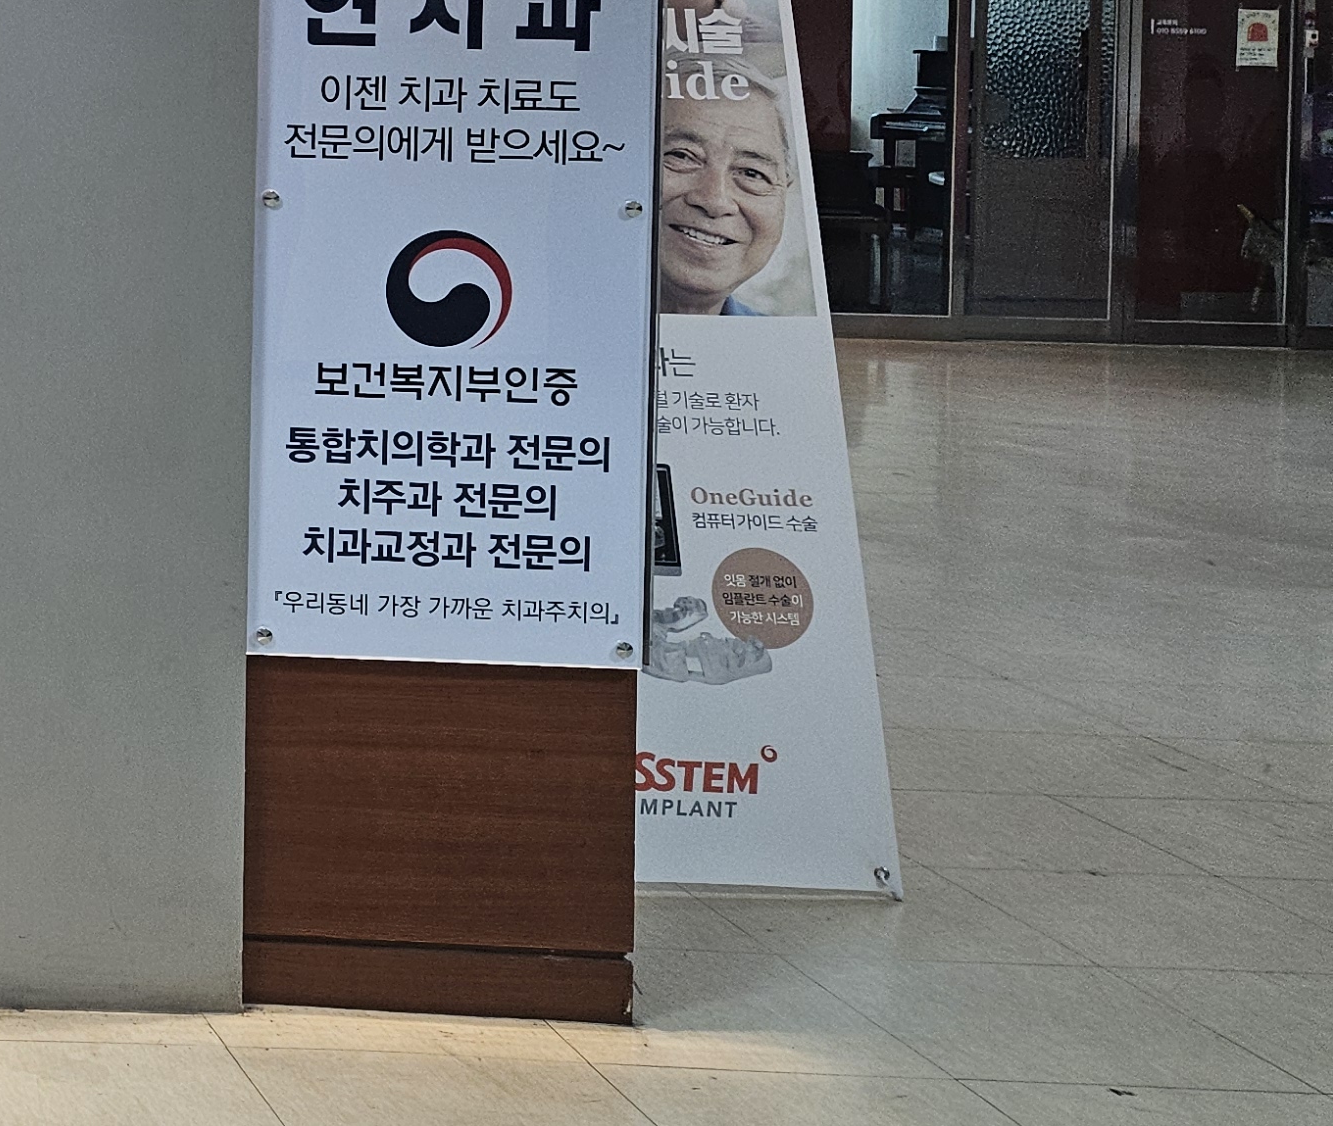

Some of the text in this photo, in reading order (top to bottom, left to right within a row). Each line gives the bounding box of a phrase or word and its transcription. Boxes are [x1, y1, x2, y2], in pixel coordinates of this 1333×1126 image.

[320, 75, 581, 114] 이젠 치과 치료도
[284, 124, 626, 166] 전문의에게 받으세요~
[314, 362, 579, 407] 보건복지부인증
[672, 391, 722, 410] 기술로
[724, 392, 759, 411] 환자
[691, 416, 780, 436] 가능합니다.
[285, 426, 611, 473] 통합치의학과 전문의
[338, 478, 557, 521] 치주과 전문의
[691, 487, 813, 507] OneGuide
[786, 515, 818, 532] 수술
[303, 526, 592, 572] 치과교정과 전문의
[724, 574, 746, 587] 잇몸
[748, 575, 771, 588] 절개
[377, 594, 421, 618] 가장
[429, 596, 494, 620] 가까운
[722, 592, 766, 605] 임플란트
[730, 611, 763, 624] 가능한
